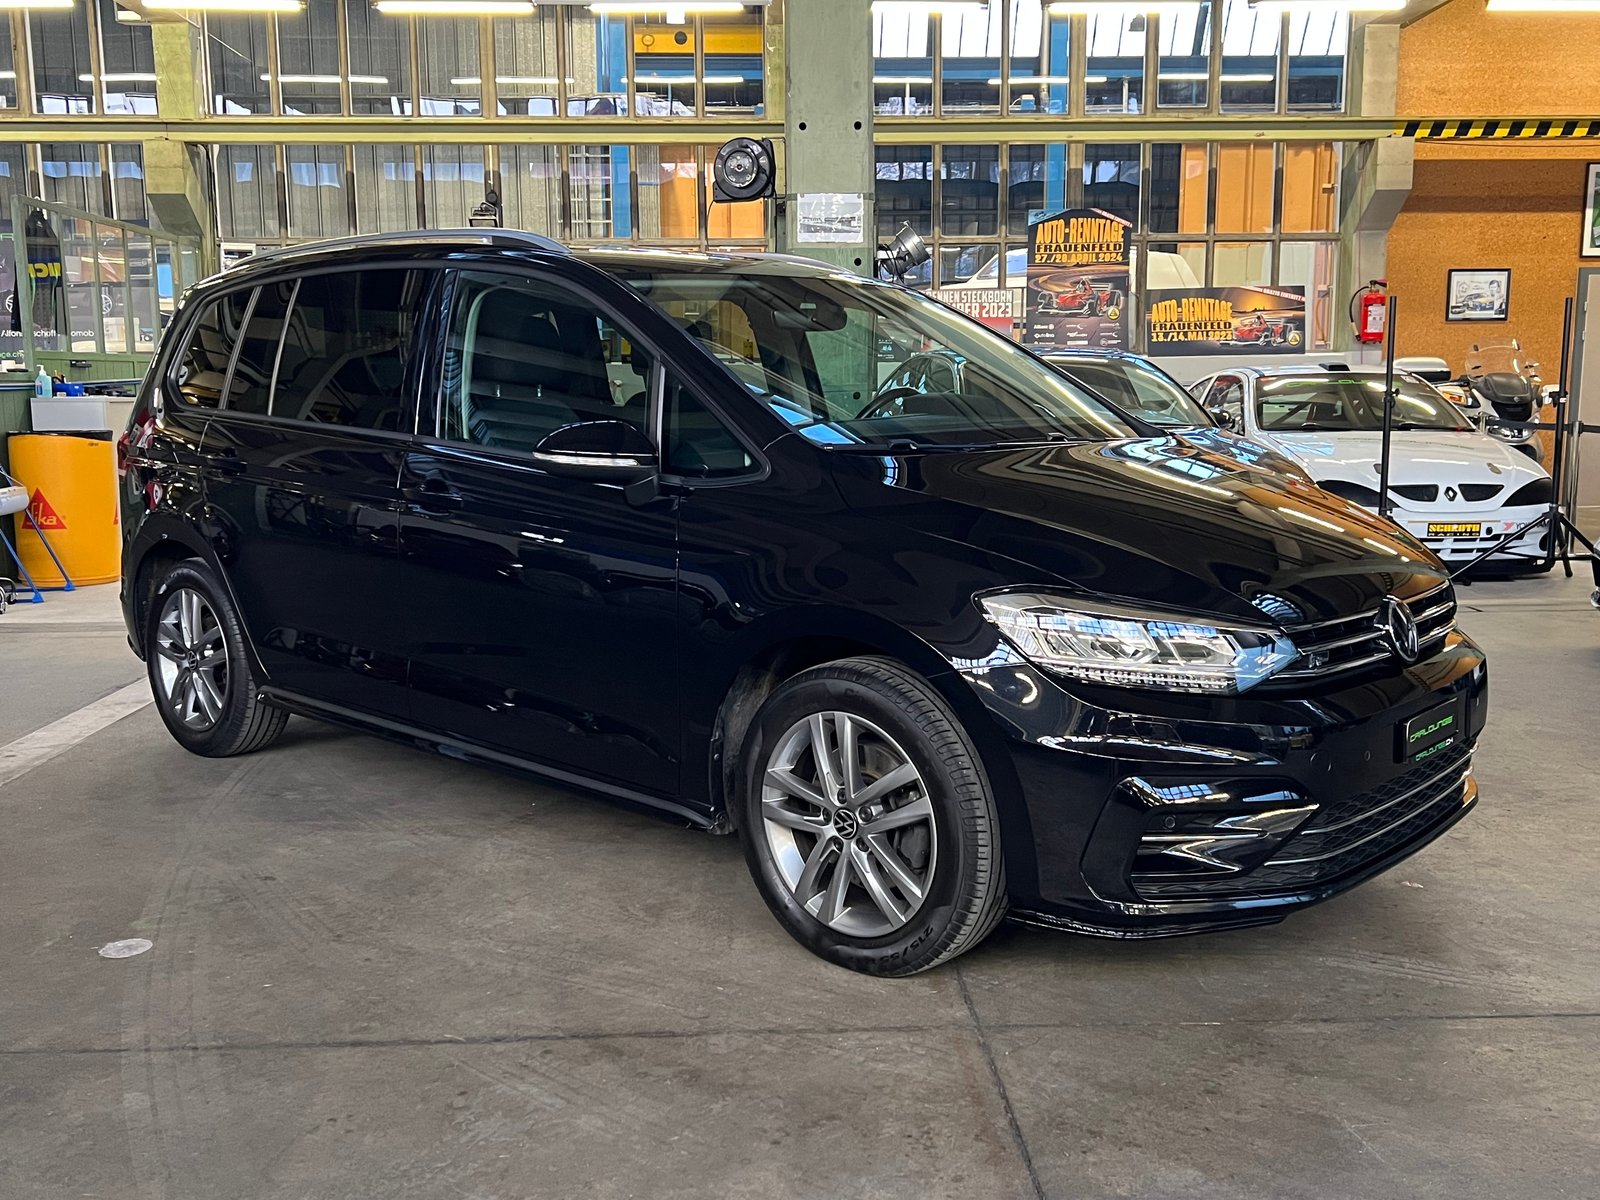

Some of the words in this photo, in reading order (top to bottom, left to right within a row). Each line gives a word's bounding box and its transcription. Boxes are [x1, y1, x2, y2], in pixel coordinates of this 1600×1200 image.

[1036, 217, 1124, 243] AUTO-RENNTAGE
[1036, 243, 1123, 252] FRAUENFELD
[1099, 253, 1123, 262] 2024
[961, 289, 1013, 303] STECKBORN
[982, 302, 1013, 318] 2023
[1151, 297, 1233, 323] AUTO-RENNTAGE
[1152, 321, 1232, 331] FRAUENFELD
[1208, 331, 1233, 341] 2023
[1428, 523, 1480, 533] SCHROTH
